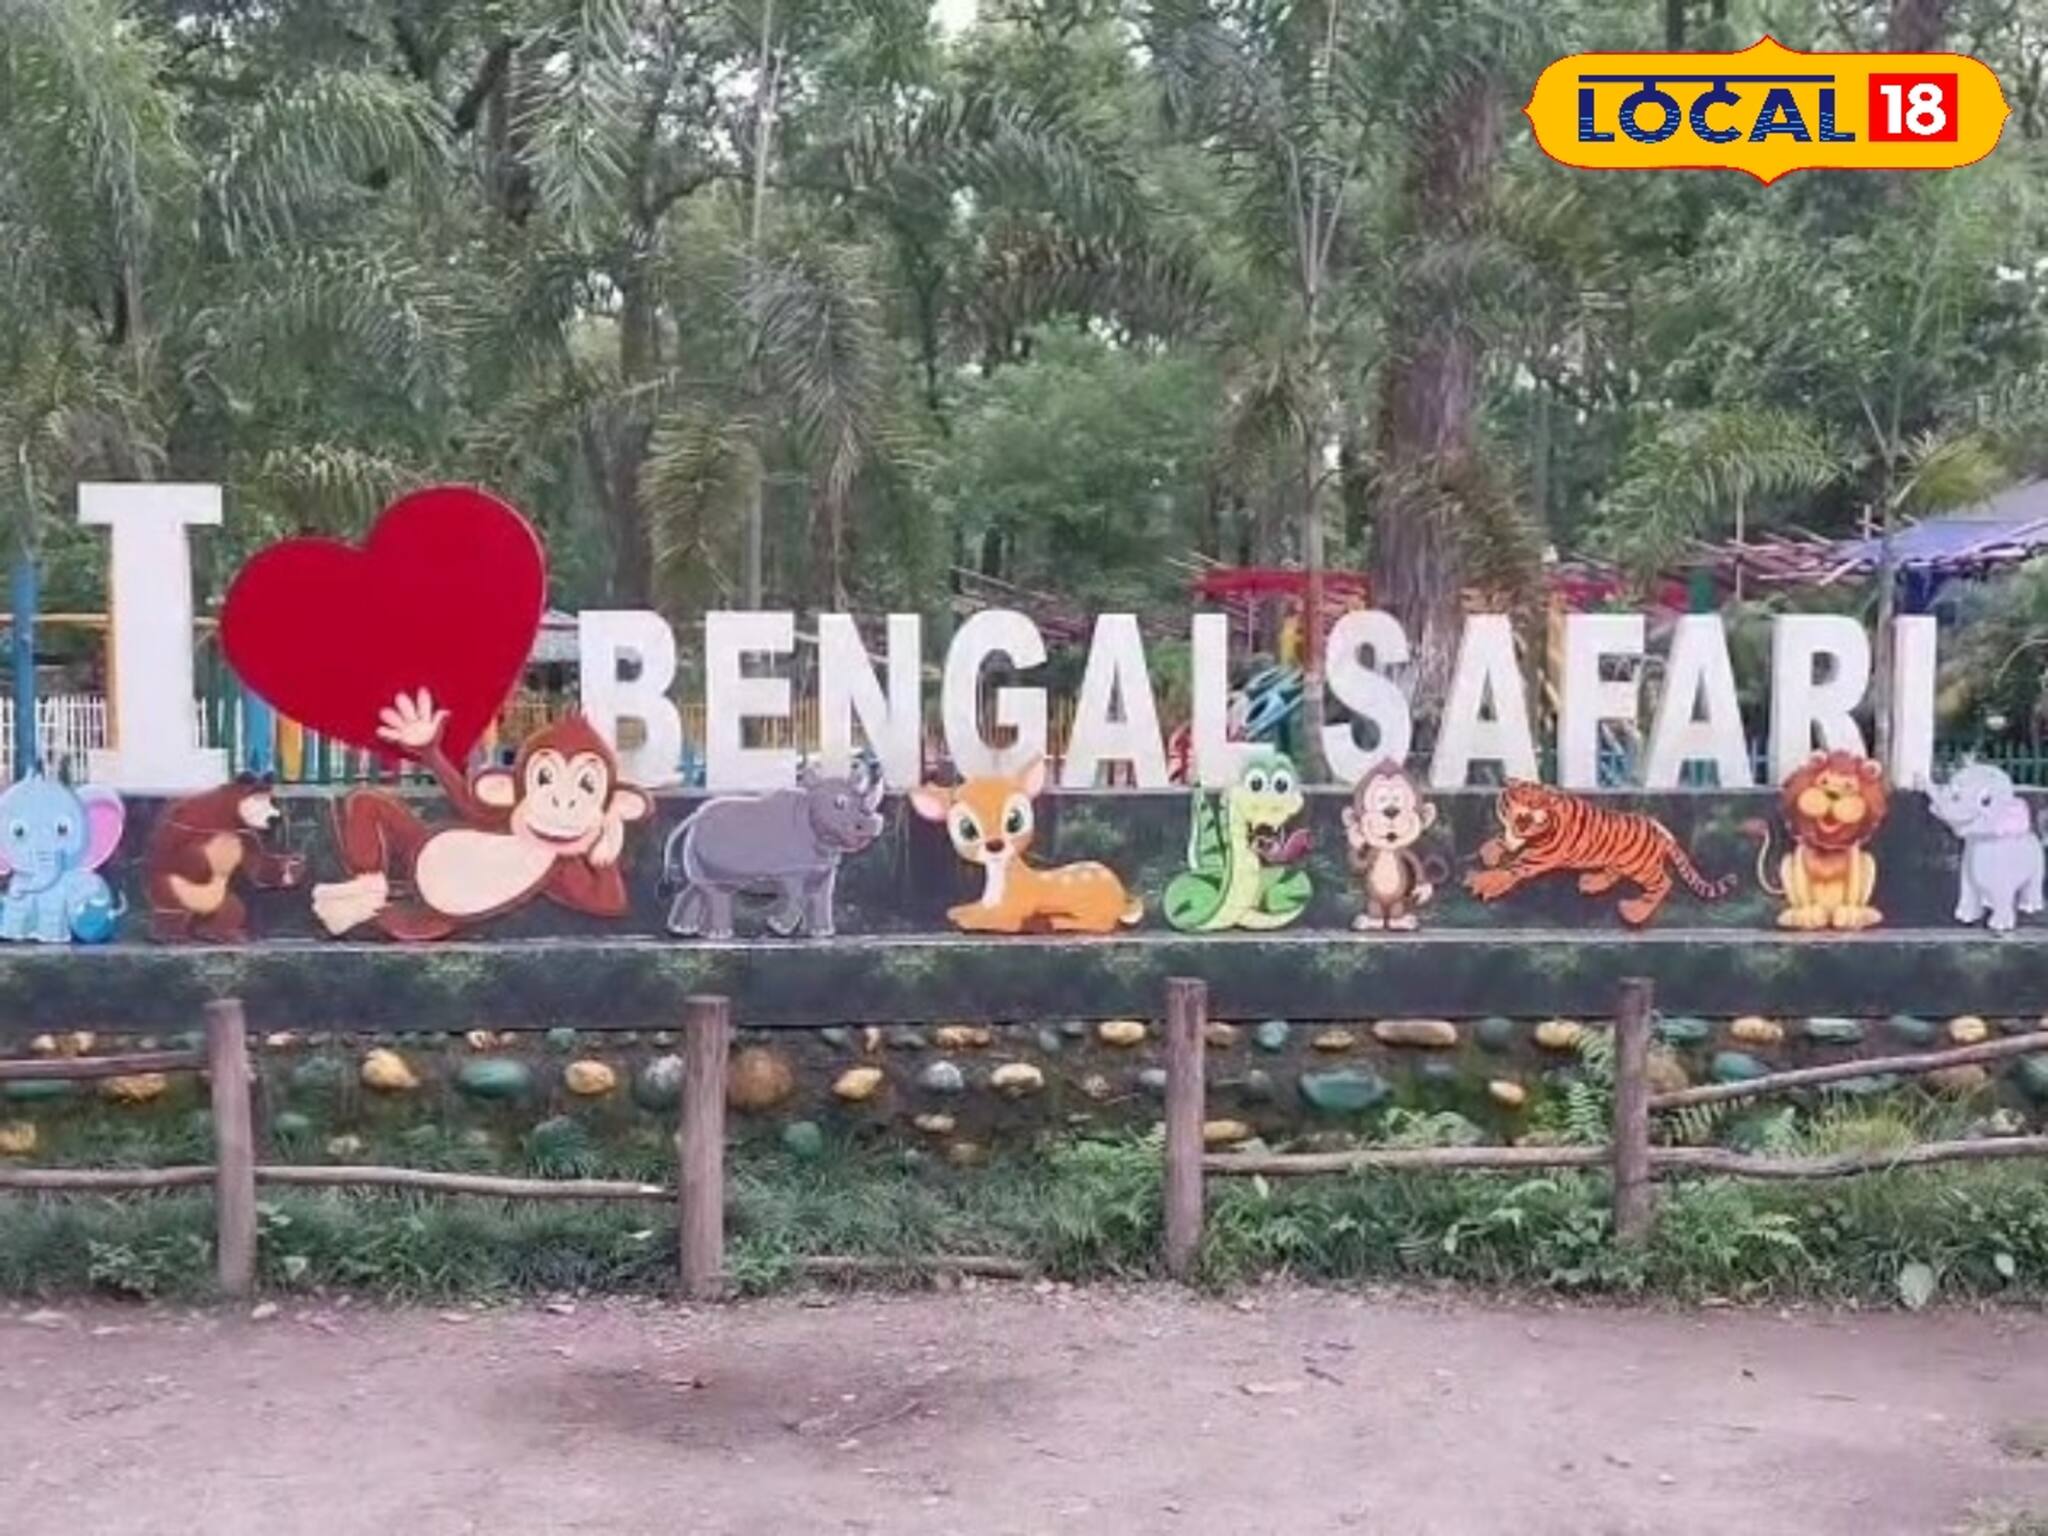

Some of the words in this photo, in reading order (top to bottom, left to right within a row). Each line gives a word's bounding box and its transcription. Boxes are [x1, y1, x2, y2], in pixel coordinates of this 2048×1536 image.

[78, 483, 229, 790] I
[578, 610, 1278, 790] BENGAL
[1322, 610, 1938, 789] SAFARI
